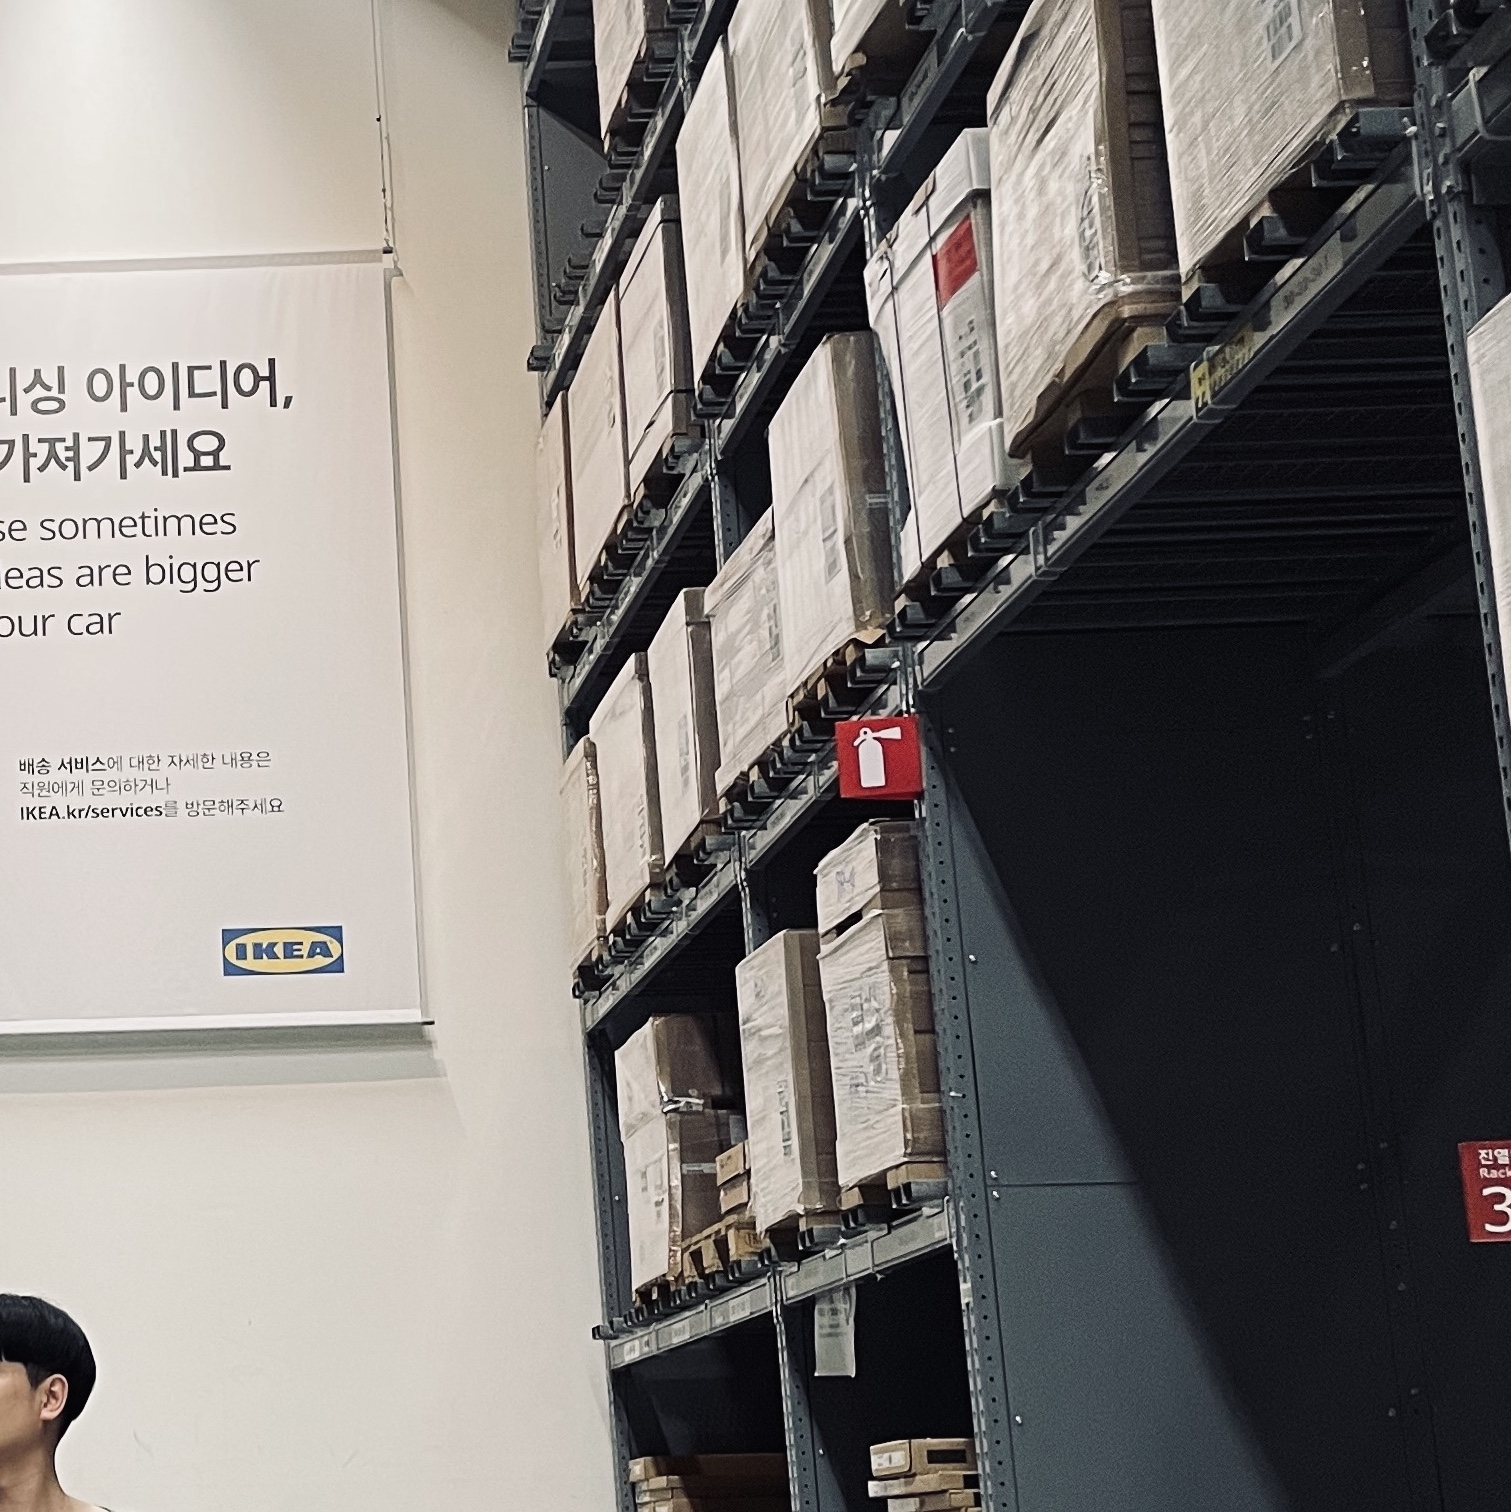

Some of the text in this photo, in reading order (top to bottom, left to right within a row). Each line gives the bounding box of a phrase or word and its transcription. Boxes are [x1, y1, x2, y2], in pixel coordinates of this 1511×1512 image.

[86, 357, 294, 413] 아이디어,
[39, 507, 237, 541] sometimes
[75, 563, 132, 588] are
[145, 554, 261, 594] bigger
[67, 611, 122, 636] car
[19, 751, 272, 776] 배송 서비스에 대한 자세한 내용은
[19, 777, 172, 798] 직원에게 문의하거나
[185, 797, 285, 818] 방문해주세요
[235, 940, 334, 961] IKEA
[1478, 1148, 1511, 1165] 진열
